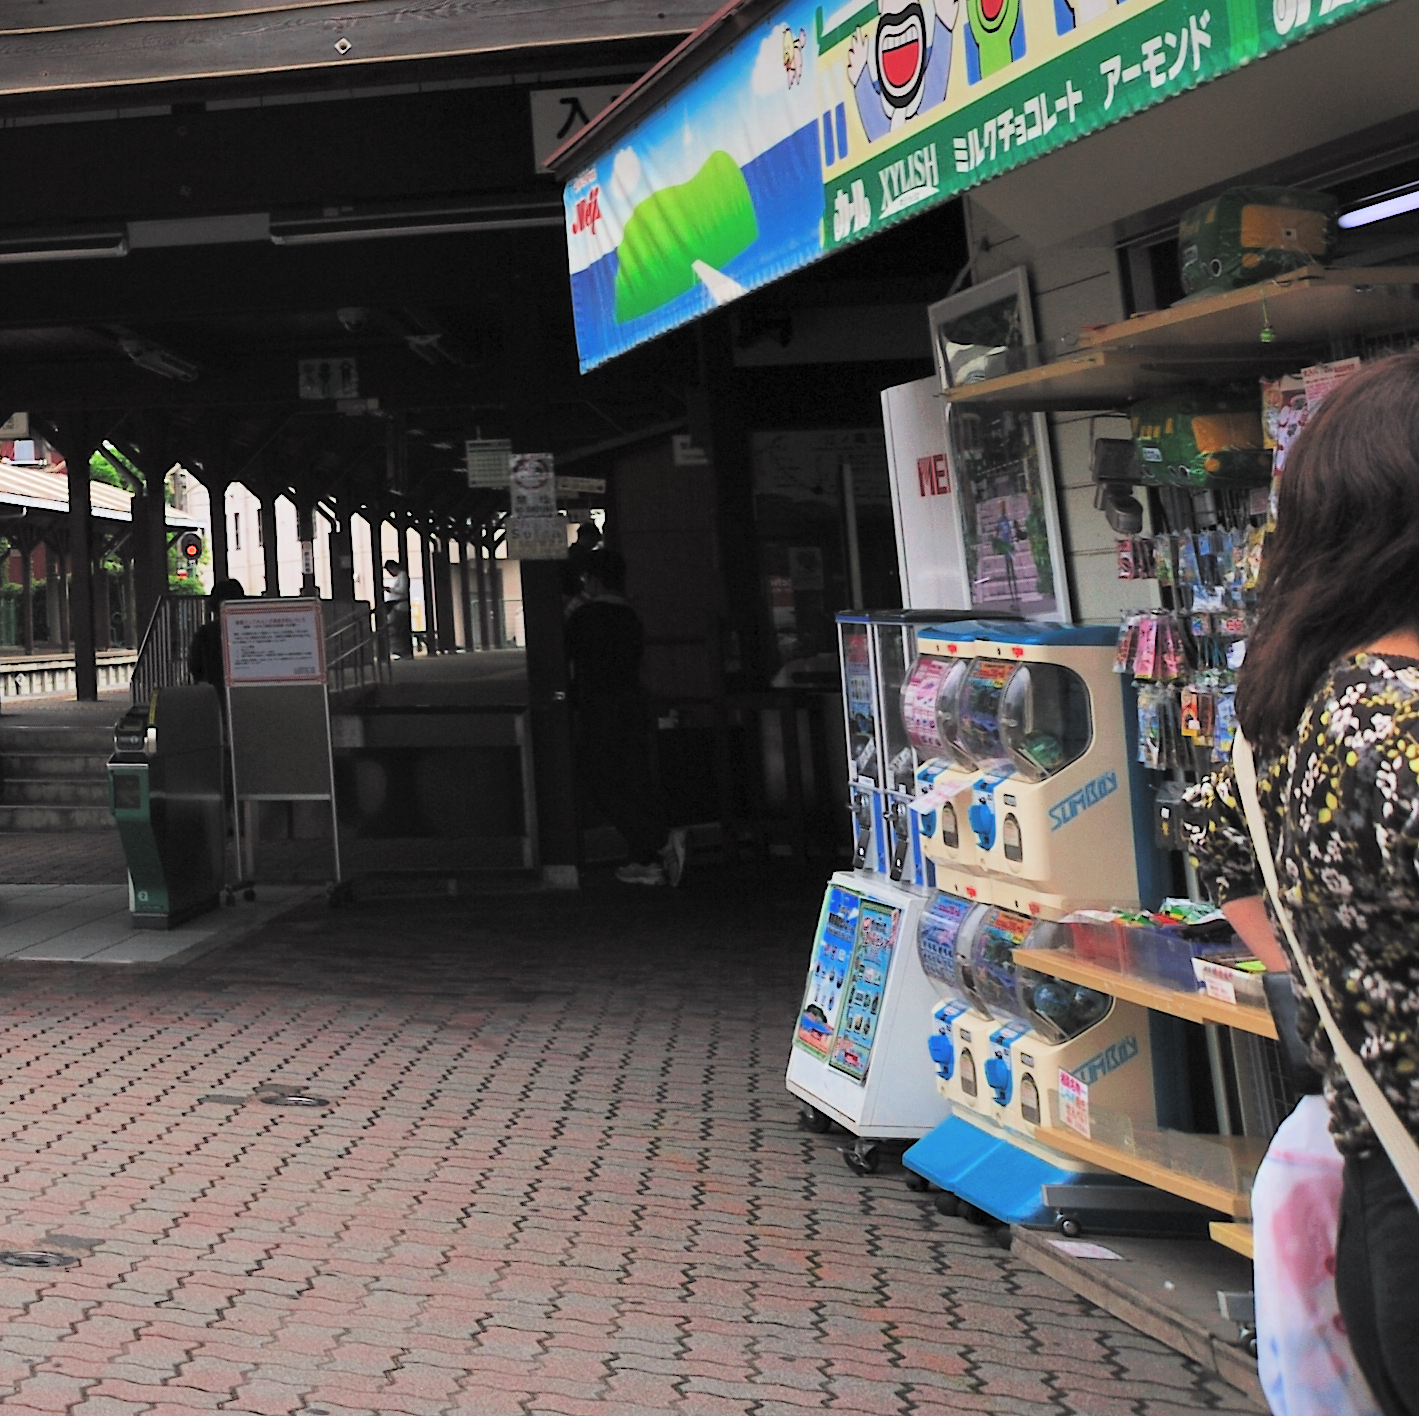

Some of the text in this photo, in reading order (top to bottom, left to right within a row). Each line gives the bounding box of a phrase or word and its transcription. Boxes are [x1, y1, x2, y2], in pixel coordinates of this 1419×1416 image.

[878, 142, 939, 214] XYLISH
[953, 79, 1083, 173] ミルクチョコレート
[1100, 9, 1211, 110] アーモンド
[916, 453, 951, 497] ME
